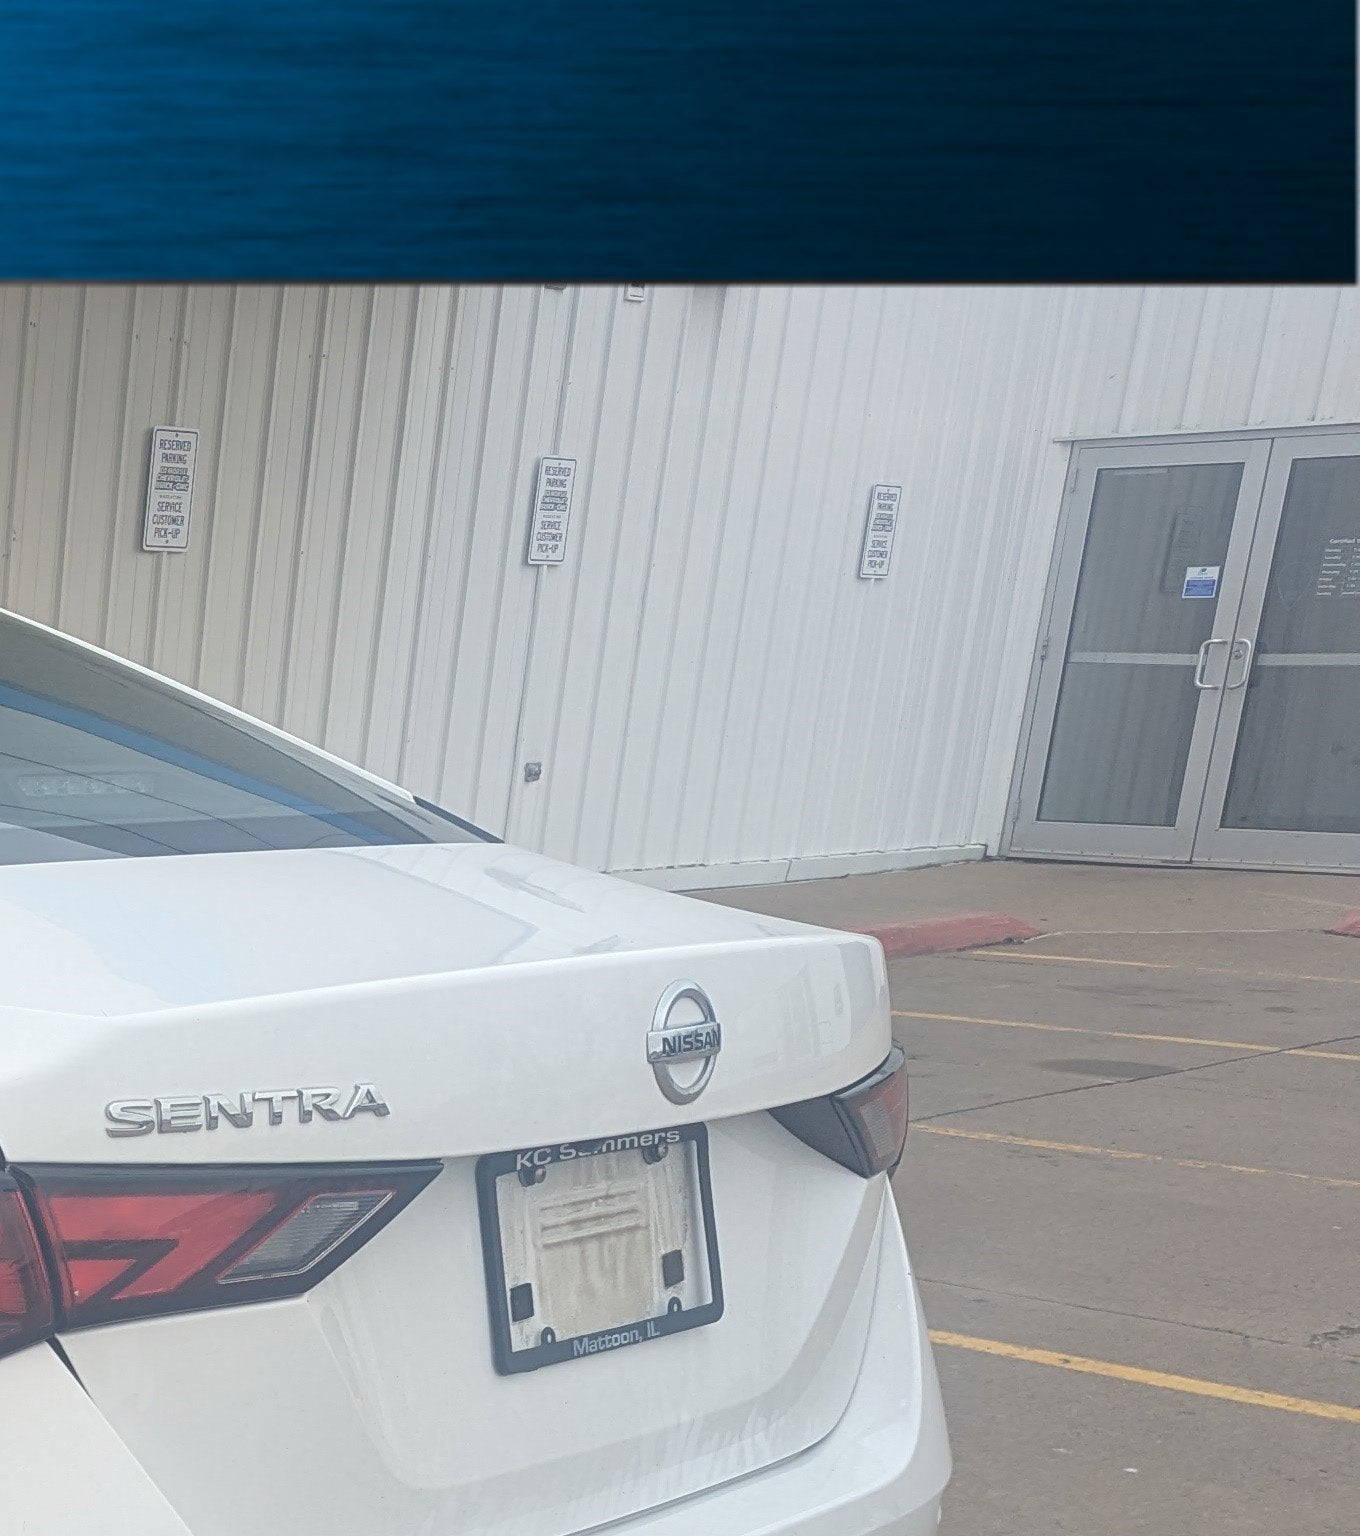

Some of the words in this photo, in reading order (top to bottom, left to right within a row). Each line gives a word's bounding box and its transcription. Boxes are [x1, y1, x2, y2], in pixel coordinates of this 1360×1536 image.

[159, 439, 191, 452] RESERVED
[161, 452, 187, 464] PARKING
[157, 501, 183, 513] SERVICE
[152, 514, 185, 526] CUSTOMER
[153, 527, 181, 539] PICK-UP
[661, 1028, 721, 1055] NISSAN
[104, 1081, 391, 1139] SENTRA
[515, 1146, 552, 1171] KC
[572, 1329, 643, 1357] Mattoon,
[645, 1320, 661, 1338] IL
